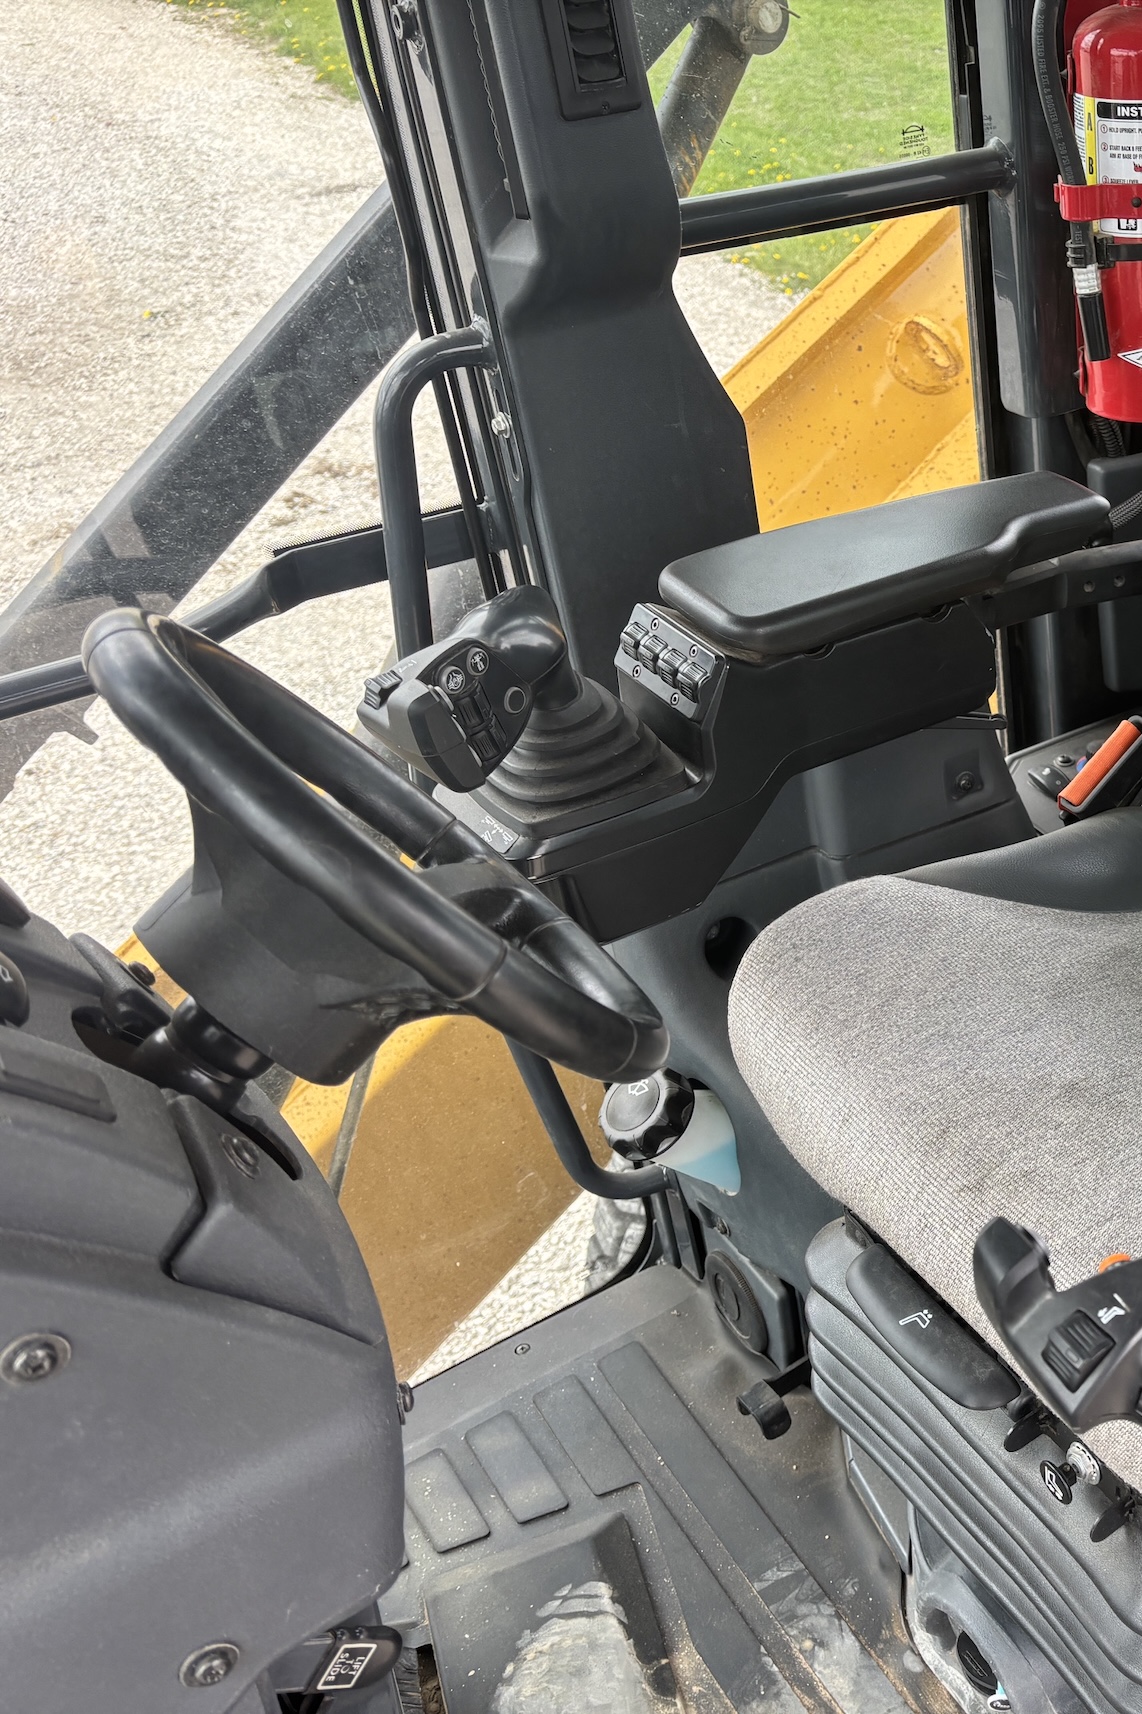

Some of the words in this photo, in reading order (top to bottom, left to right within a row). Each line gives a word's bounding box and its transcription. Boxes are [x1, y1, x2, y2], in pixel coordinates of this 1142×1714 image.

[1038, 58, 1048, 74] FIRE
[1045, 94, 1058, 123] BOOSTER
[1087, 112, 1093, 131] A
[1052, 123, 1064, 140] HOSE
[1057, 141, 1068, 156] 250
[1088, 156, 1094, 175] B
[325, 1652, 350, 1682] SLIDE
[340, 1658, 354, 1674] TO
[348, 1656, 365, 1675] LIFT
